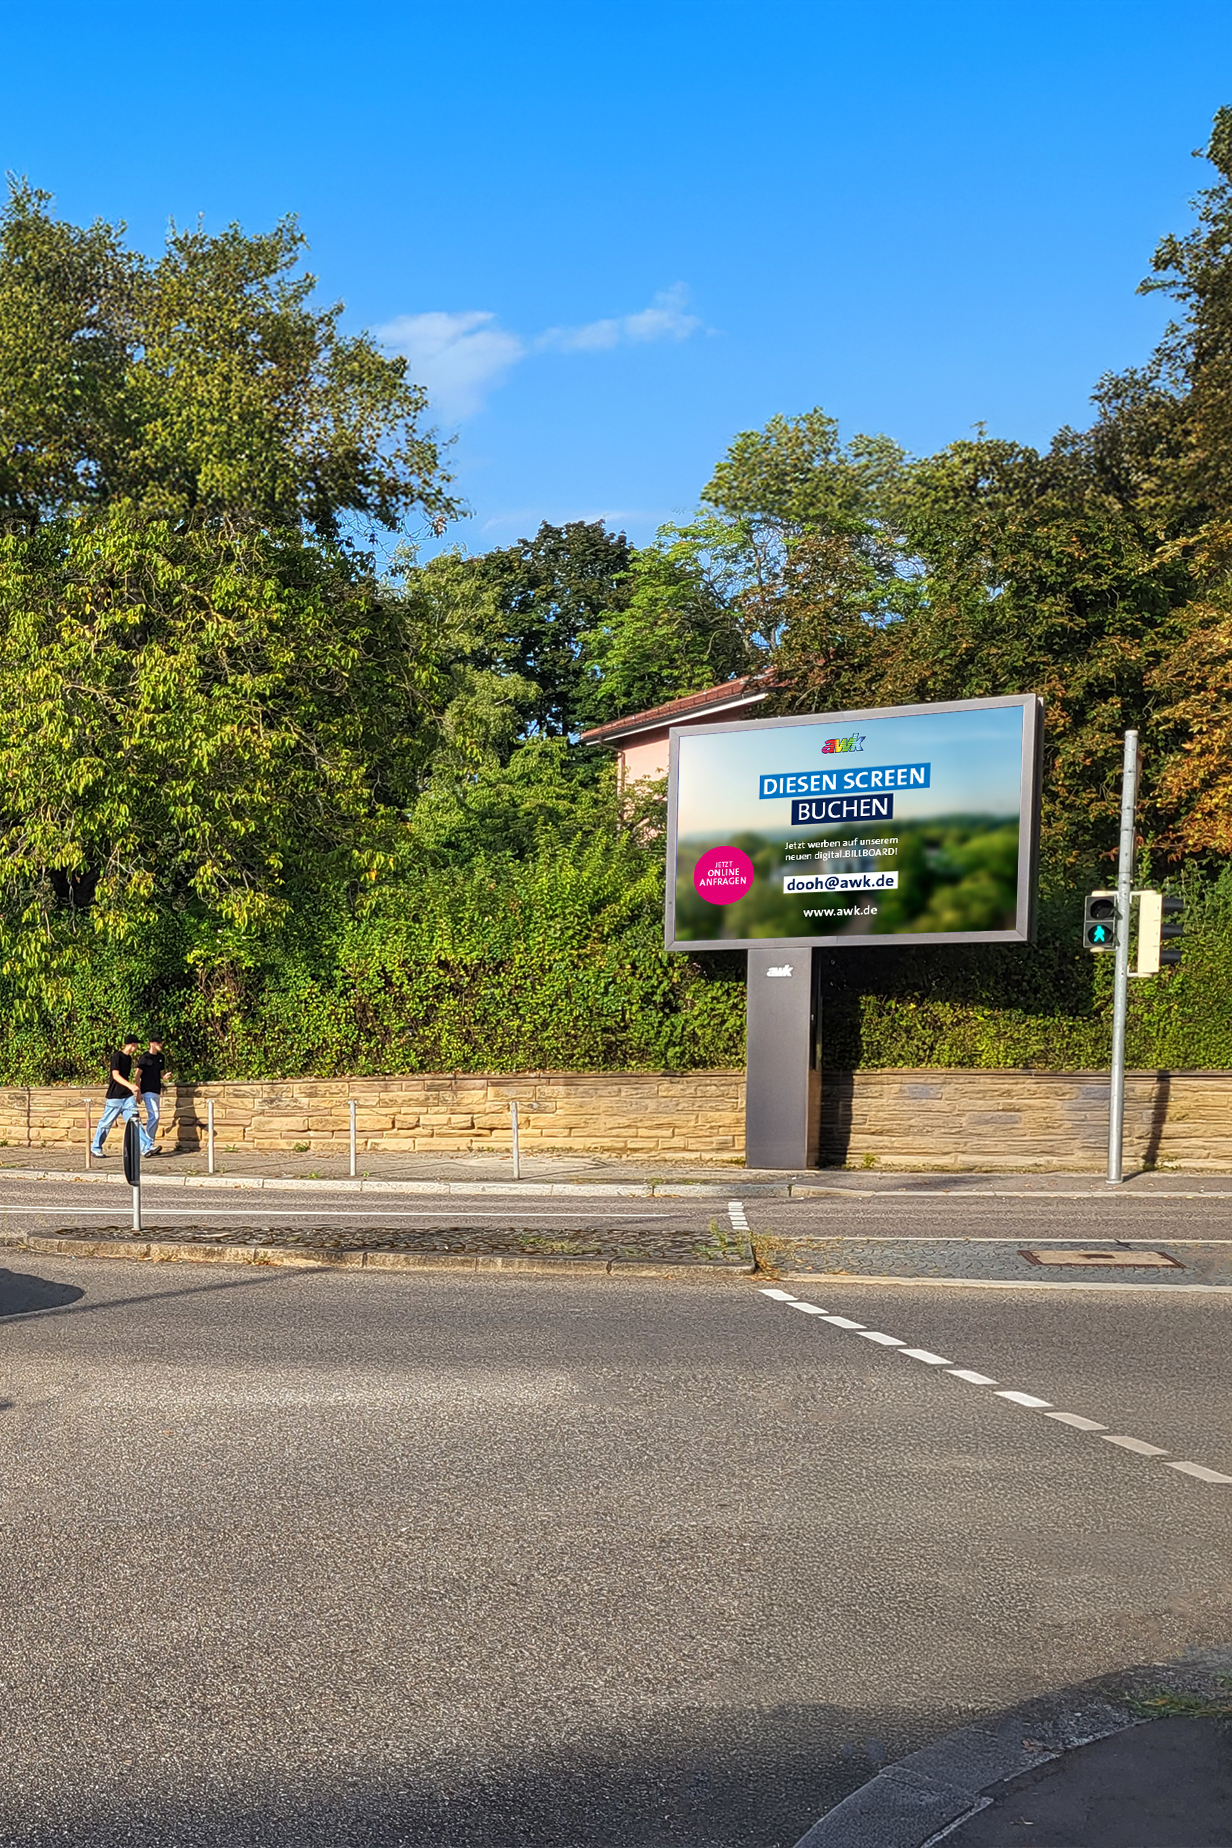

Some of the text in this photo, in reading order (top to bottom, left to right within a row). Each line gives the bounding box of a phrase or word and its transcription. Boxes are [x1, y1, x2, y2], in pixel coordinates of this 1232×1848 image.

[822, 733, 866, 754] awk
[763, 767, 925, 795] DIESEN SCREEN
[798, 797, 888, 821] BUCHEN
[785, 837, 899, 850] Jetzt werben auf unserem
[785, 853, 812, 861] neuen
[708, 868, 739, 877] ONLINE
[699, 876, 747, 886] ANFRAGEN
[787, 874, 894, 891] dooh@awk.de
[803, 905, 878, 918] www.awk.de
[766, 964, 793, 977] awk
